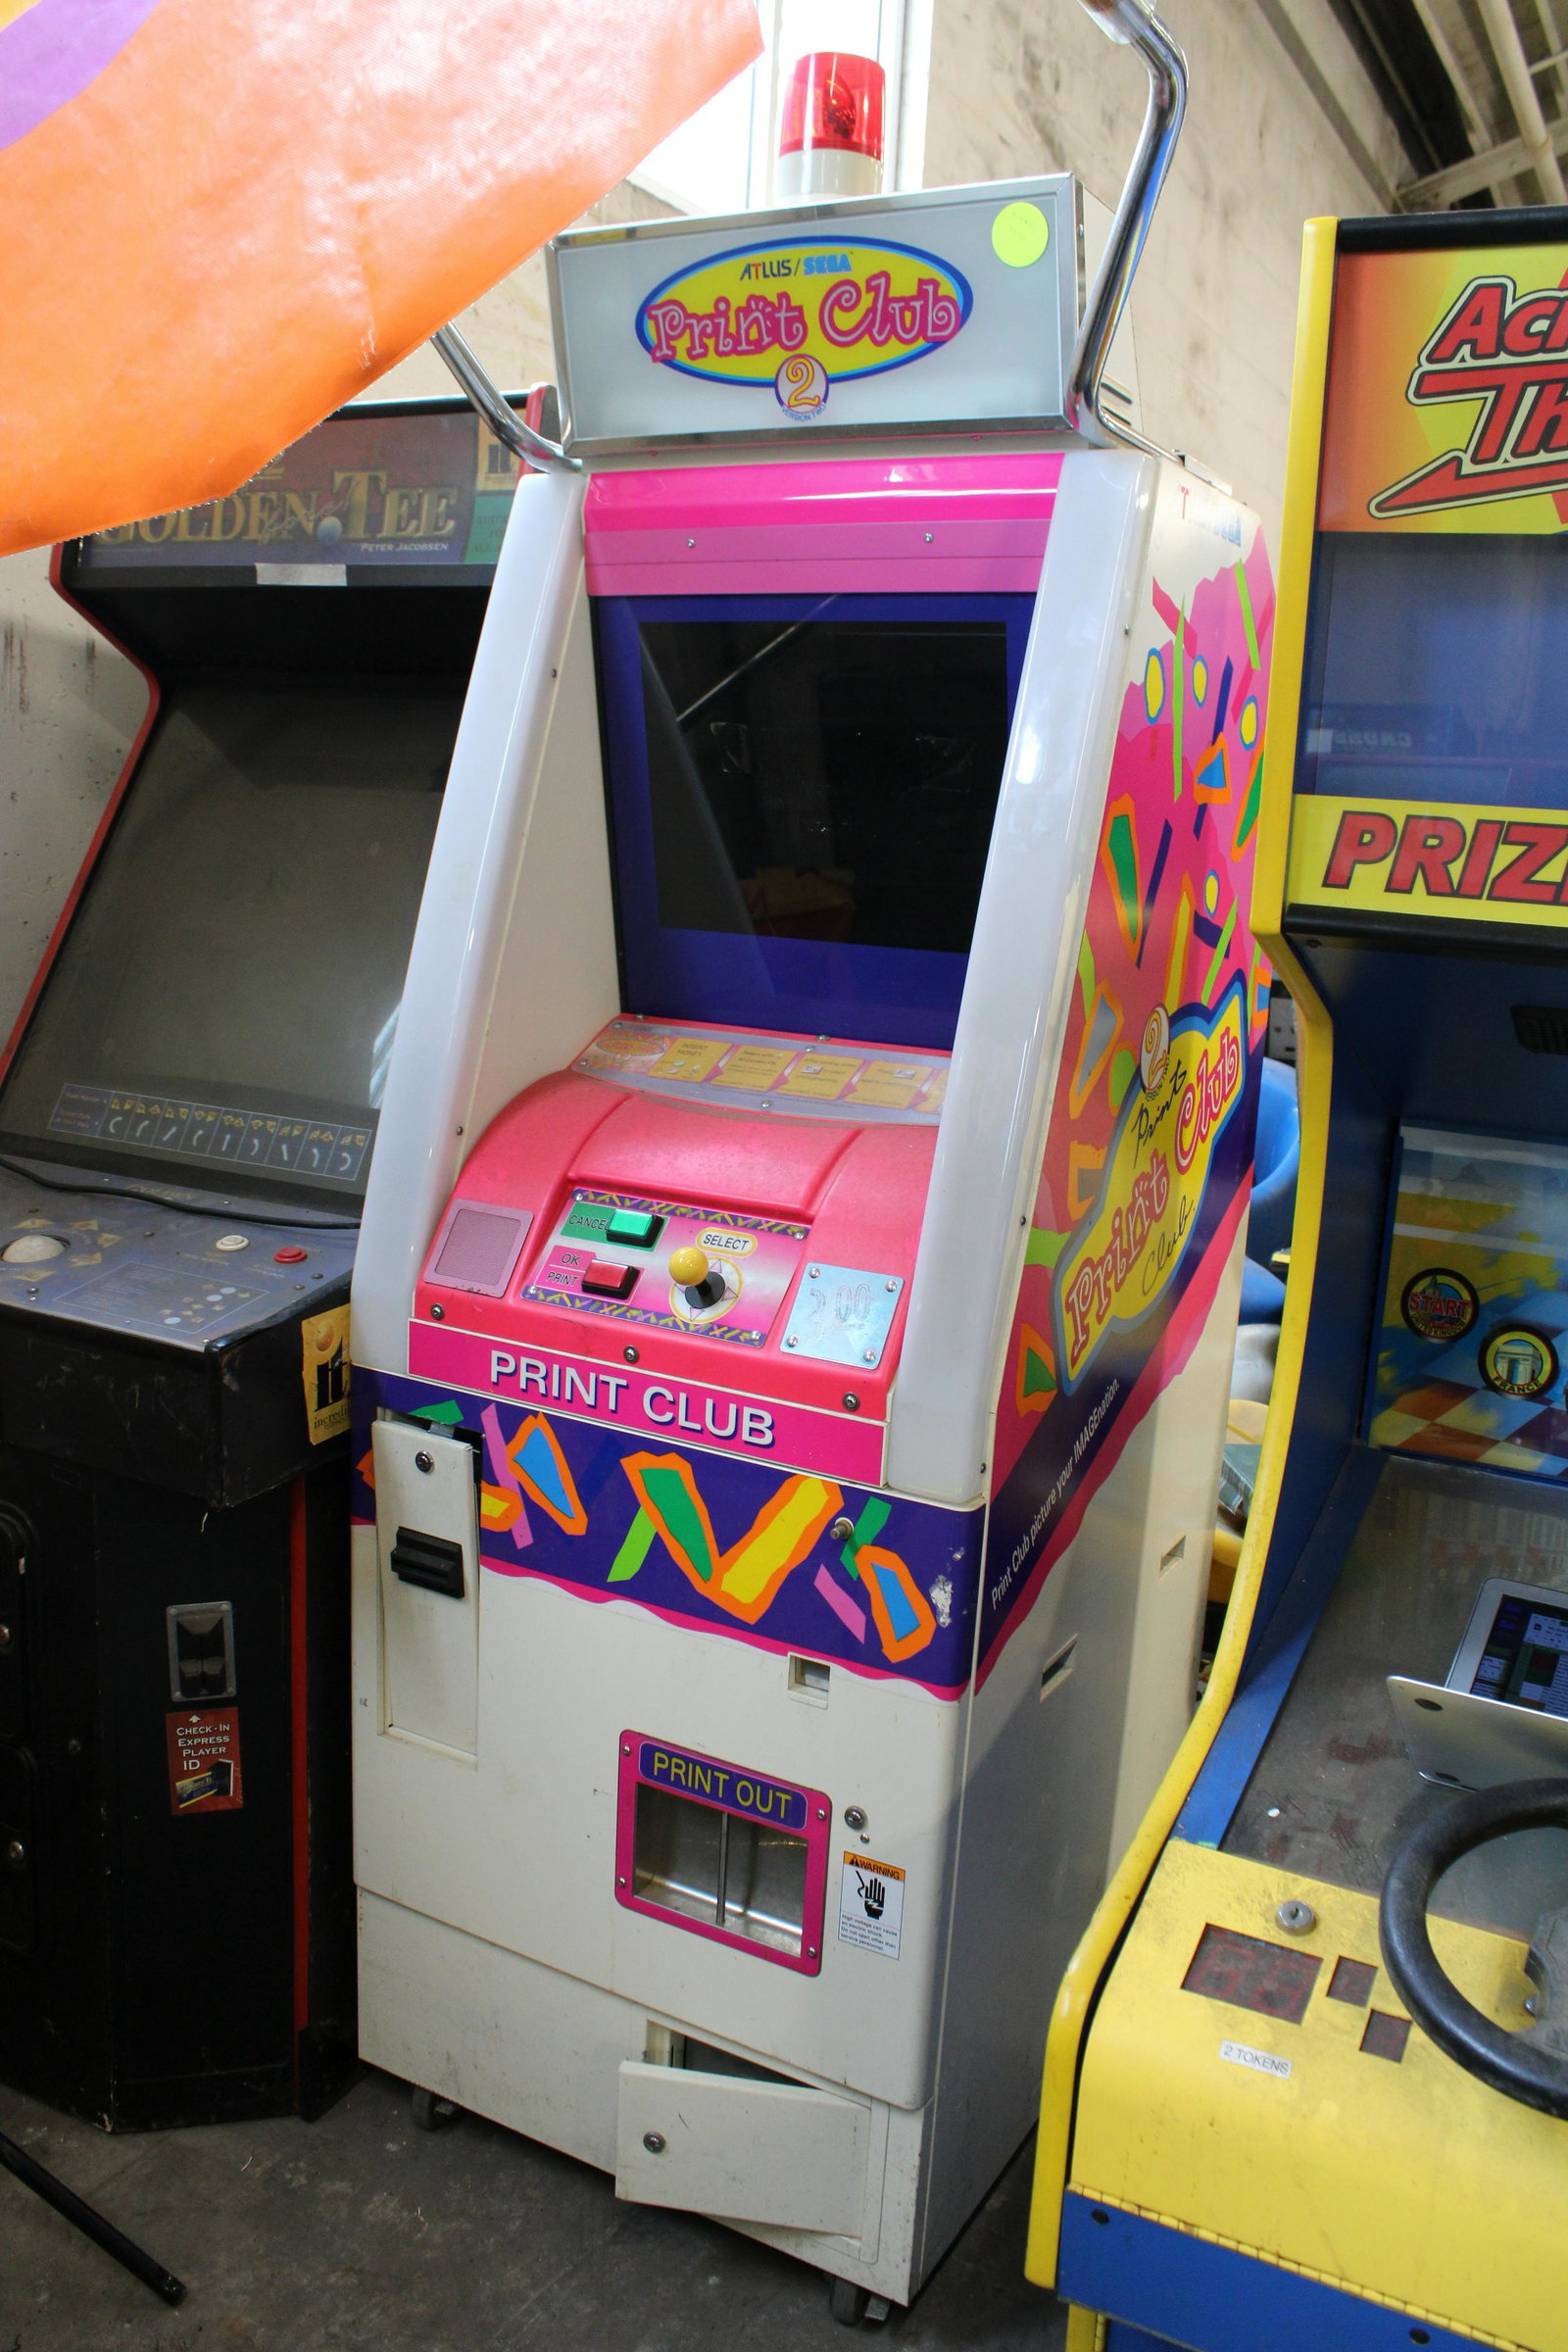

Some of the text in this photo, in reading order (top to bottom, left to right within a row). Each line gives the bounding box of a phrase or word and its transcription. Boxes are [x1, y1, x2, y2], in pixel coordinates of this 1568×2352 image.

[648, 270, 960, 362] Print Club
[786, 357, 820, 407] 2
[1407, 365, 1568, 468] Th
[334, 470, 458, 539] TEE
[361, 542, 449, 552] PETER JACOBSEN
[1321, 809, 1568, 907] PRIZ
[1145, 1009, 1167, 1088] 2
[1131, 1057, 1188, 1170] Print
[1065, 1026, 1242, 1370] Print Club
[568, 1214, 609, 1231] CANCEL
[703, 1234, 750, 1250] SELECT
[561, 1253, 582, 1266] OK
[546, 1271, 579, 1288] PRINT
[1409, 1292, 1472, 1318] START
[491, 1348, 775, 1447] PRINT CLUB
[1493, 1374, 1543, 1396] FRANCE
[314, 1403, 350, 1429] incredi
[992, 1566, 1012, 1610] Print
[1011, 1535, 1030, 1574] Club
[1030, 1489, 1057, 1546] picture
[1056, 1457, 1074, 1498] your
[176, 1725, 212, 1737] CHECK
[178, 1736, 230, 1747] EXPRESS
[182, 1746, 226, 1757] PLAYER
[183, 1759, 201, 1771] ID
[653, 1750, 792, 1820] PRINT OUT
[859, 1858, 900, 1881] WARNING
[1224, 2045, 1289, 2076] 2 TOKENS
